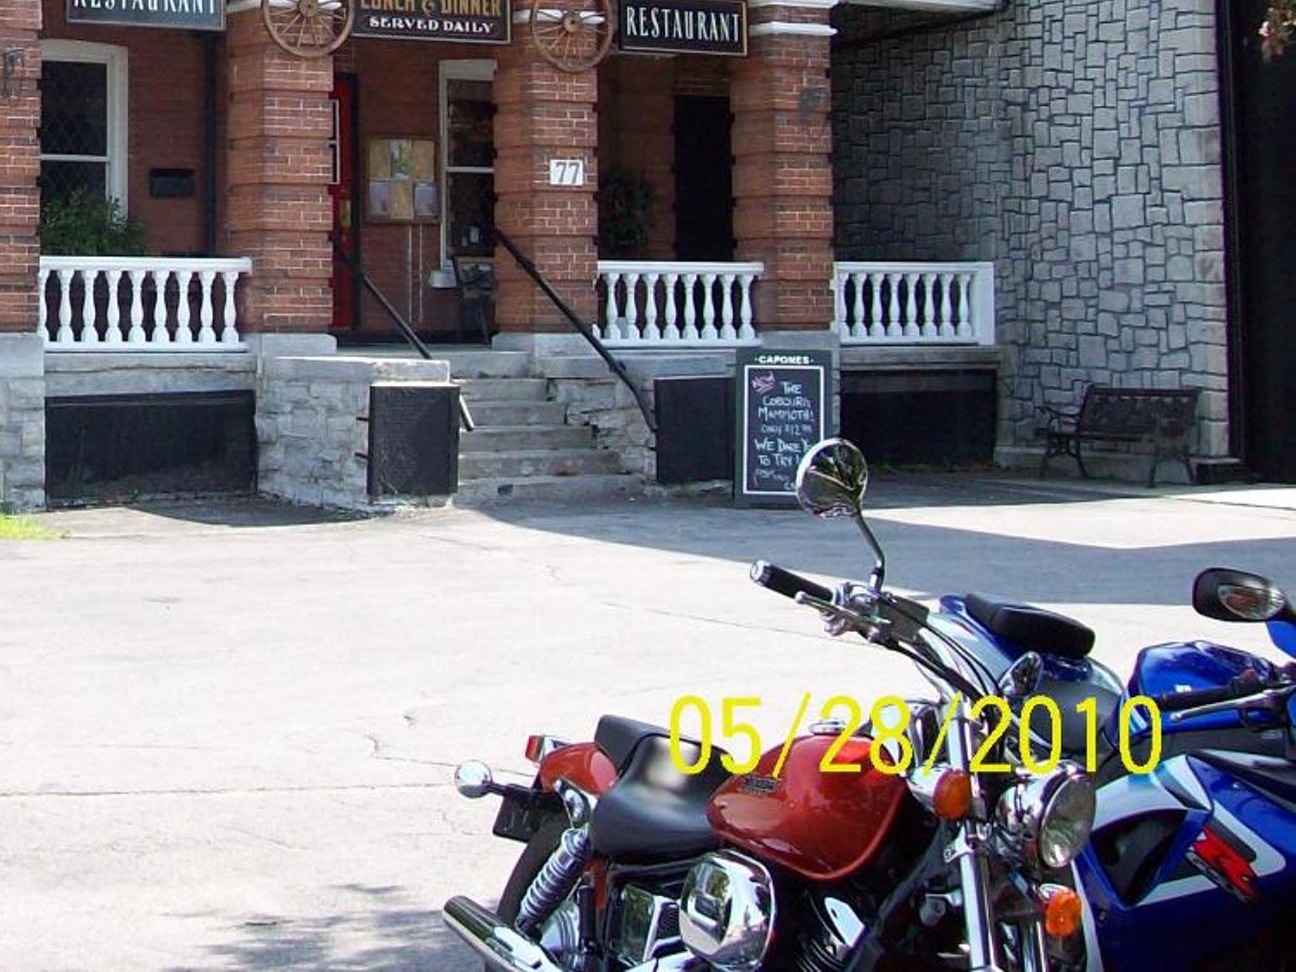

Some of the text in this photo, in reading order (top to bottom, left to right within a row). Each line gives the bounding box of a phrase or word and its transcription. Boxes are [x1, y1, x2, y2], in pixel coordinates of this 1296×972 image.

[369, 15, 494, 34] SERVED DAILY
[626, 6, 741, 42] RESTAURANT
[555, 161, 581, 184] 77
[780, 381, 803, 395] THE
[754, 437, 775, 451] WE
[758, 454, 771, 467] TO
